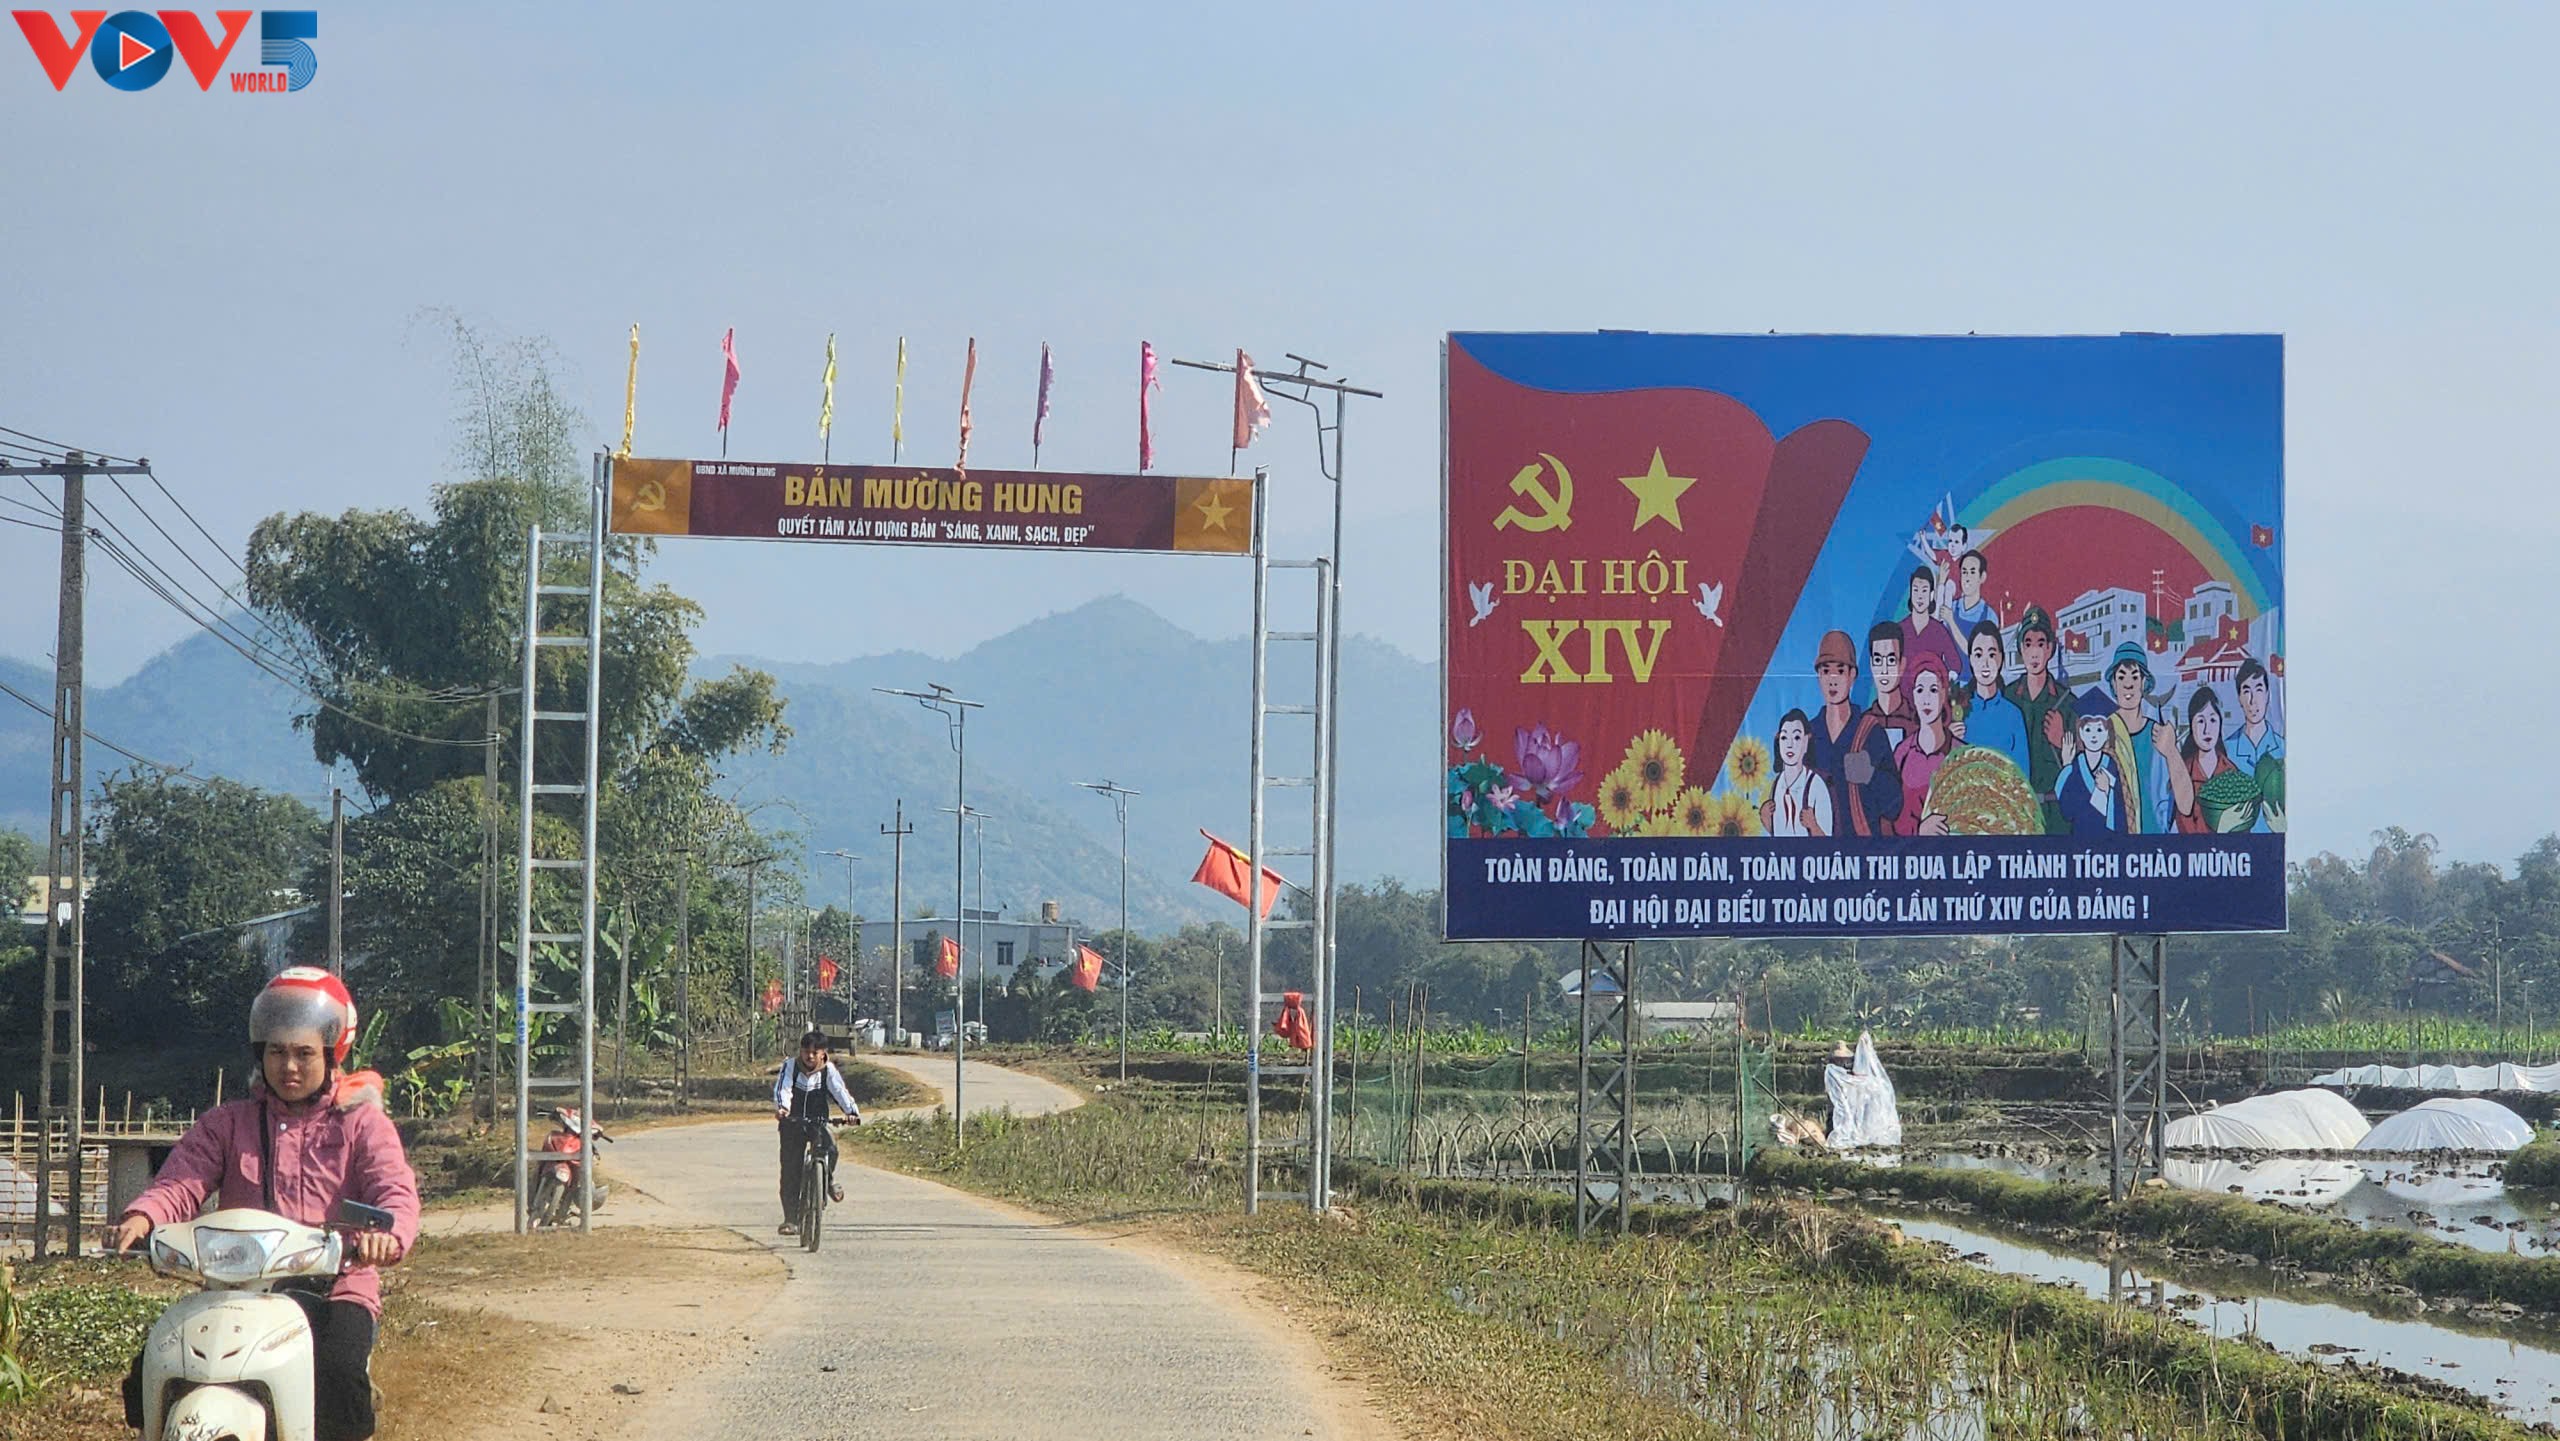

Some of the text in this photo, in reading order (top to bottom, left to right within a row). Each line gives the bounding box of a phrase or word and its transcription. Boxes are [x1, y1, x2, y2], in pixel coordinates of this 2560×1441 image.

[784, 466, 1083, 515] BẢN MƯỜNG HUNG
[777, 513, 816, 537] QUYẾT
[818, 516, 845, 536] TÂM
[847, 517, 873, 537] XÂY
[874, 519, 908, 540] DỰNG
[910, 517, 937, 539] BẢN
[985, 523, 1022, 543] XANH,
[1024, 524, 1061, 545] SẠCH,
[1502, 549, 1689, 604] ĐẠI HỘI
[1519, 619, 1672, 684] XIV
[1485, 848, 2251, 885] TOÀN ĐẢNG, TOÀN DÂN, TOÀN QUÂN THI ĐUA LẬP THÀNH TÍCH CHÀO MỪNG
[1589, 899, 1626, 929] ĐẠI
[1632, 894, 1669, 929] HỘI
[1674, 898, 1711, 929] ĐẠI
[1717, 888, 1766, 924] BIỂU
[1771, 892, 1827, 923] TOÀN
[1833, 888, 1890, 925] QUỐC
[1896, 888, 1938, 922] LẦN
[1943, 891, 1985, 921] THỨ
[1989, 896, 2023, 921] XIV
[2029, 887, 2072, 921] CỦA
[2077, 887, 2136, 920] ĐẢNG
